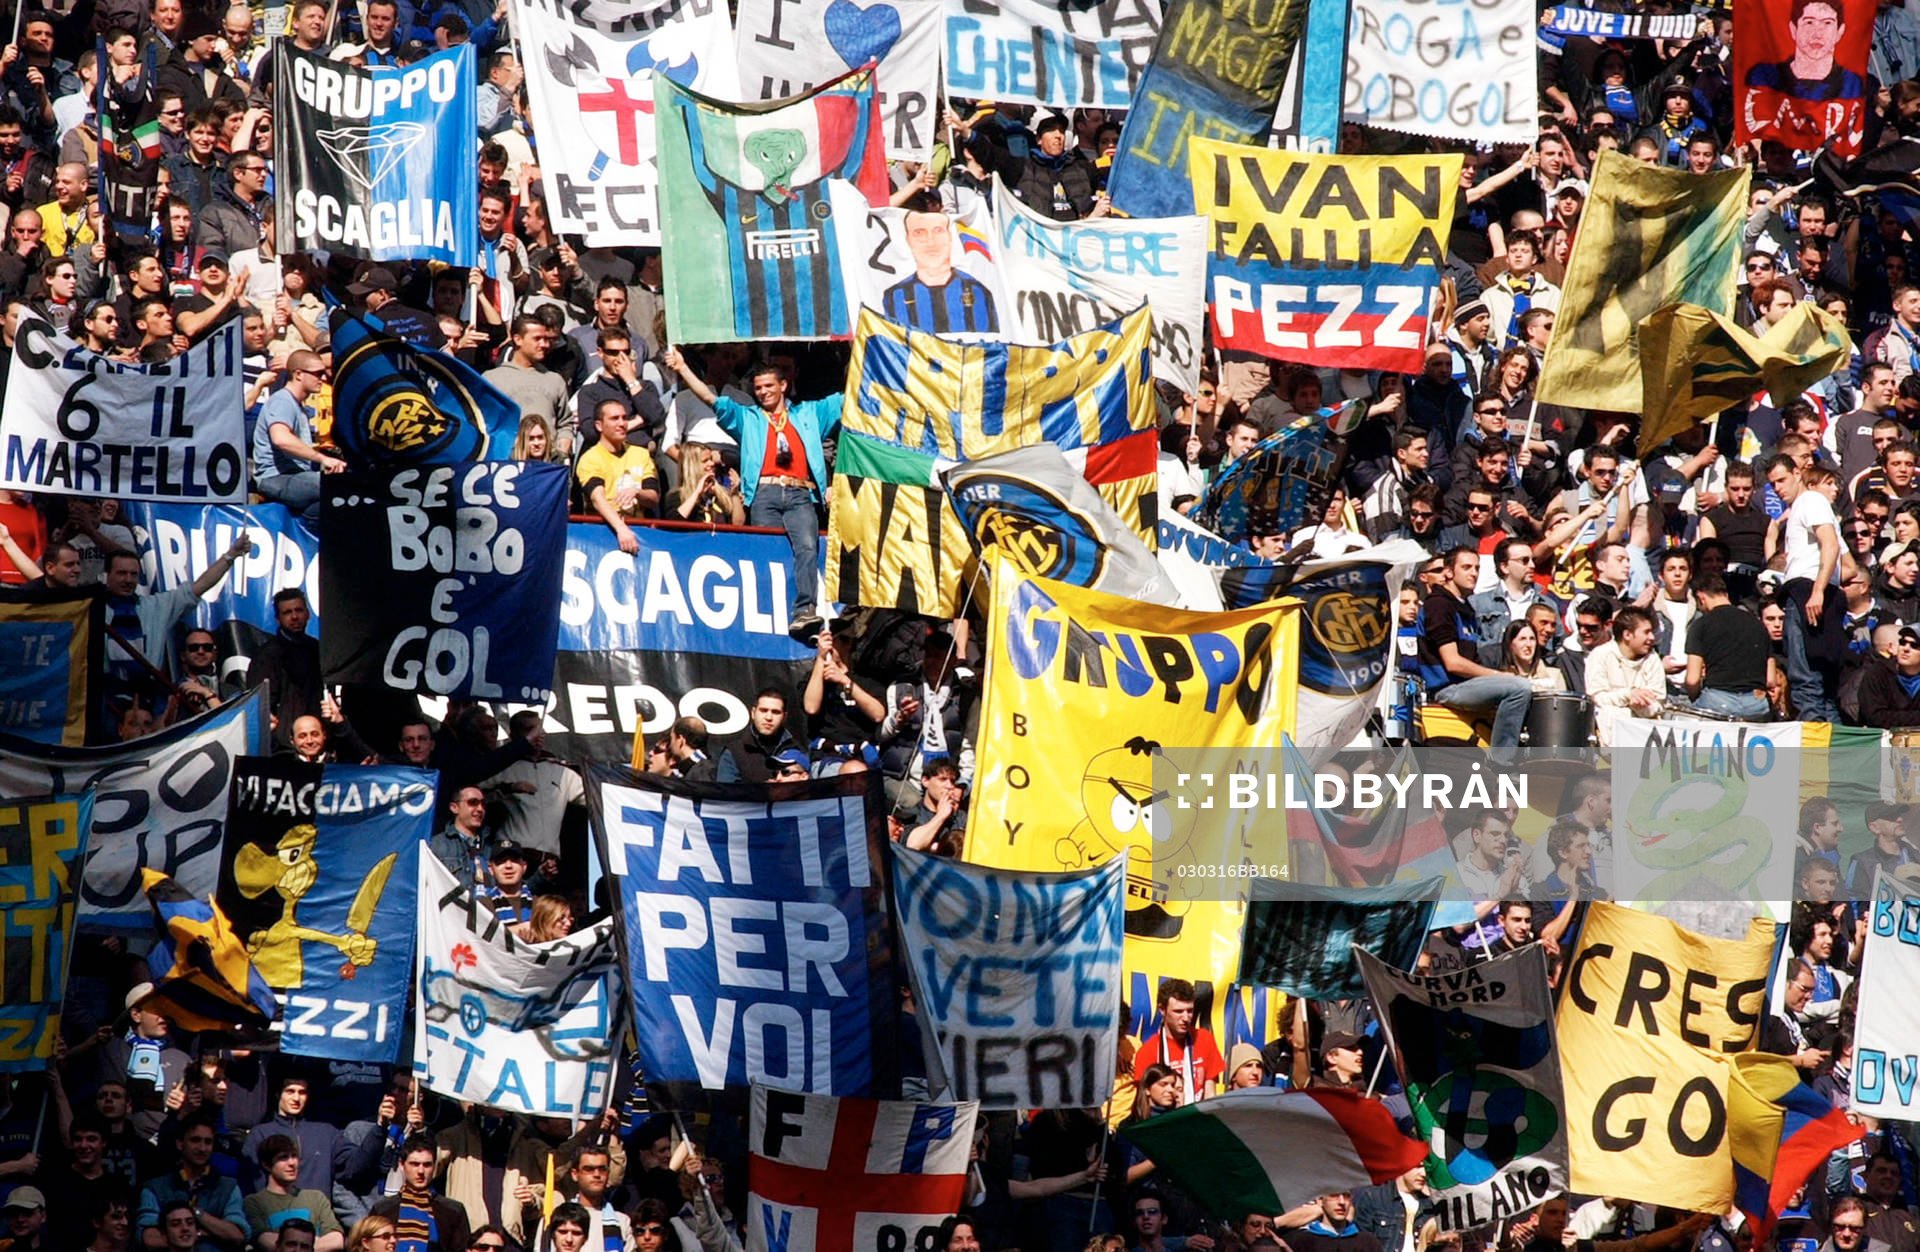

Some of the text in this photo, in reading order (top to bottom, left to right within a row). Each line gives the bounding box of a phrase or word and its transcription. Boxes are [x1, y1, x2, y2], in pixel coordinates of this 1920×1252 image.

[1557, 8, 1615, 34] JUVE
[295, 56, 456, 119] GRUPPO
[295, 189, 456, 252] SCAGLIA
[1214, 153, 1441, 221] IVAN
[866, 210, 896, 274] 2
[57, 372, 100, 441] 6
[151, 386, 194, 438] IL
[4, 434, 241, 497] MARTELLO
[389, 467, 456, 508] SE
[383, 625, 503, 698] GOL
[1007, 579, 1274, 726] GRUPPO
[263, 776, 435, 818] FACCIAMO
[601, 782, 872, 888] FATTI
[636, 892, 851, 998] PER
[670, 995, 832, 1098] VOI
[1591, 1075, 1728, 1157] GO
[1430, 1165, 1550, 1233] MILANO
